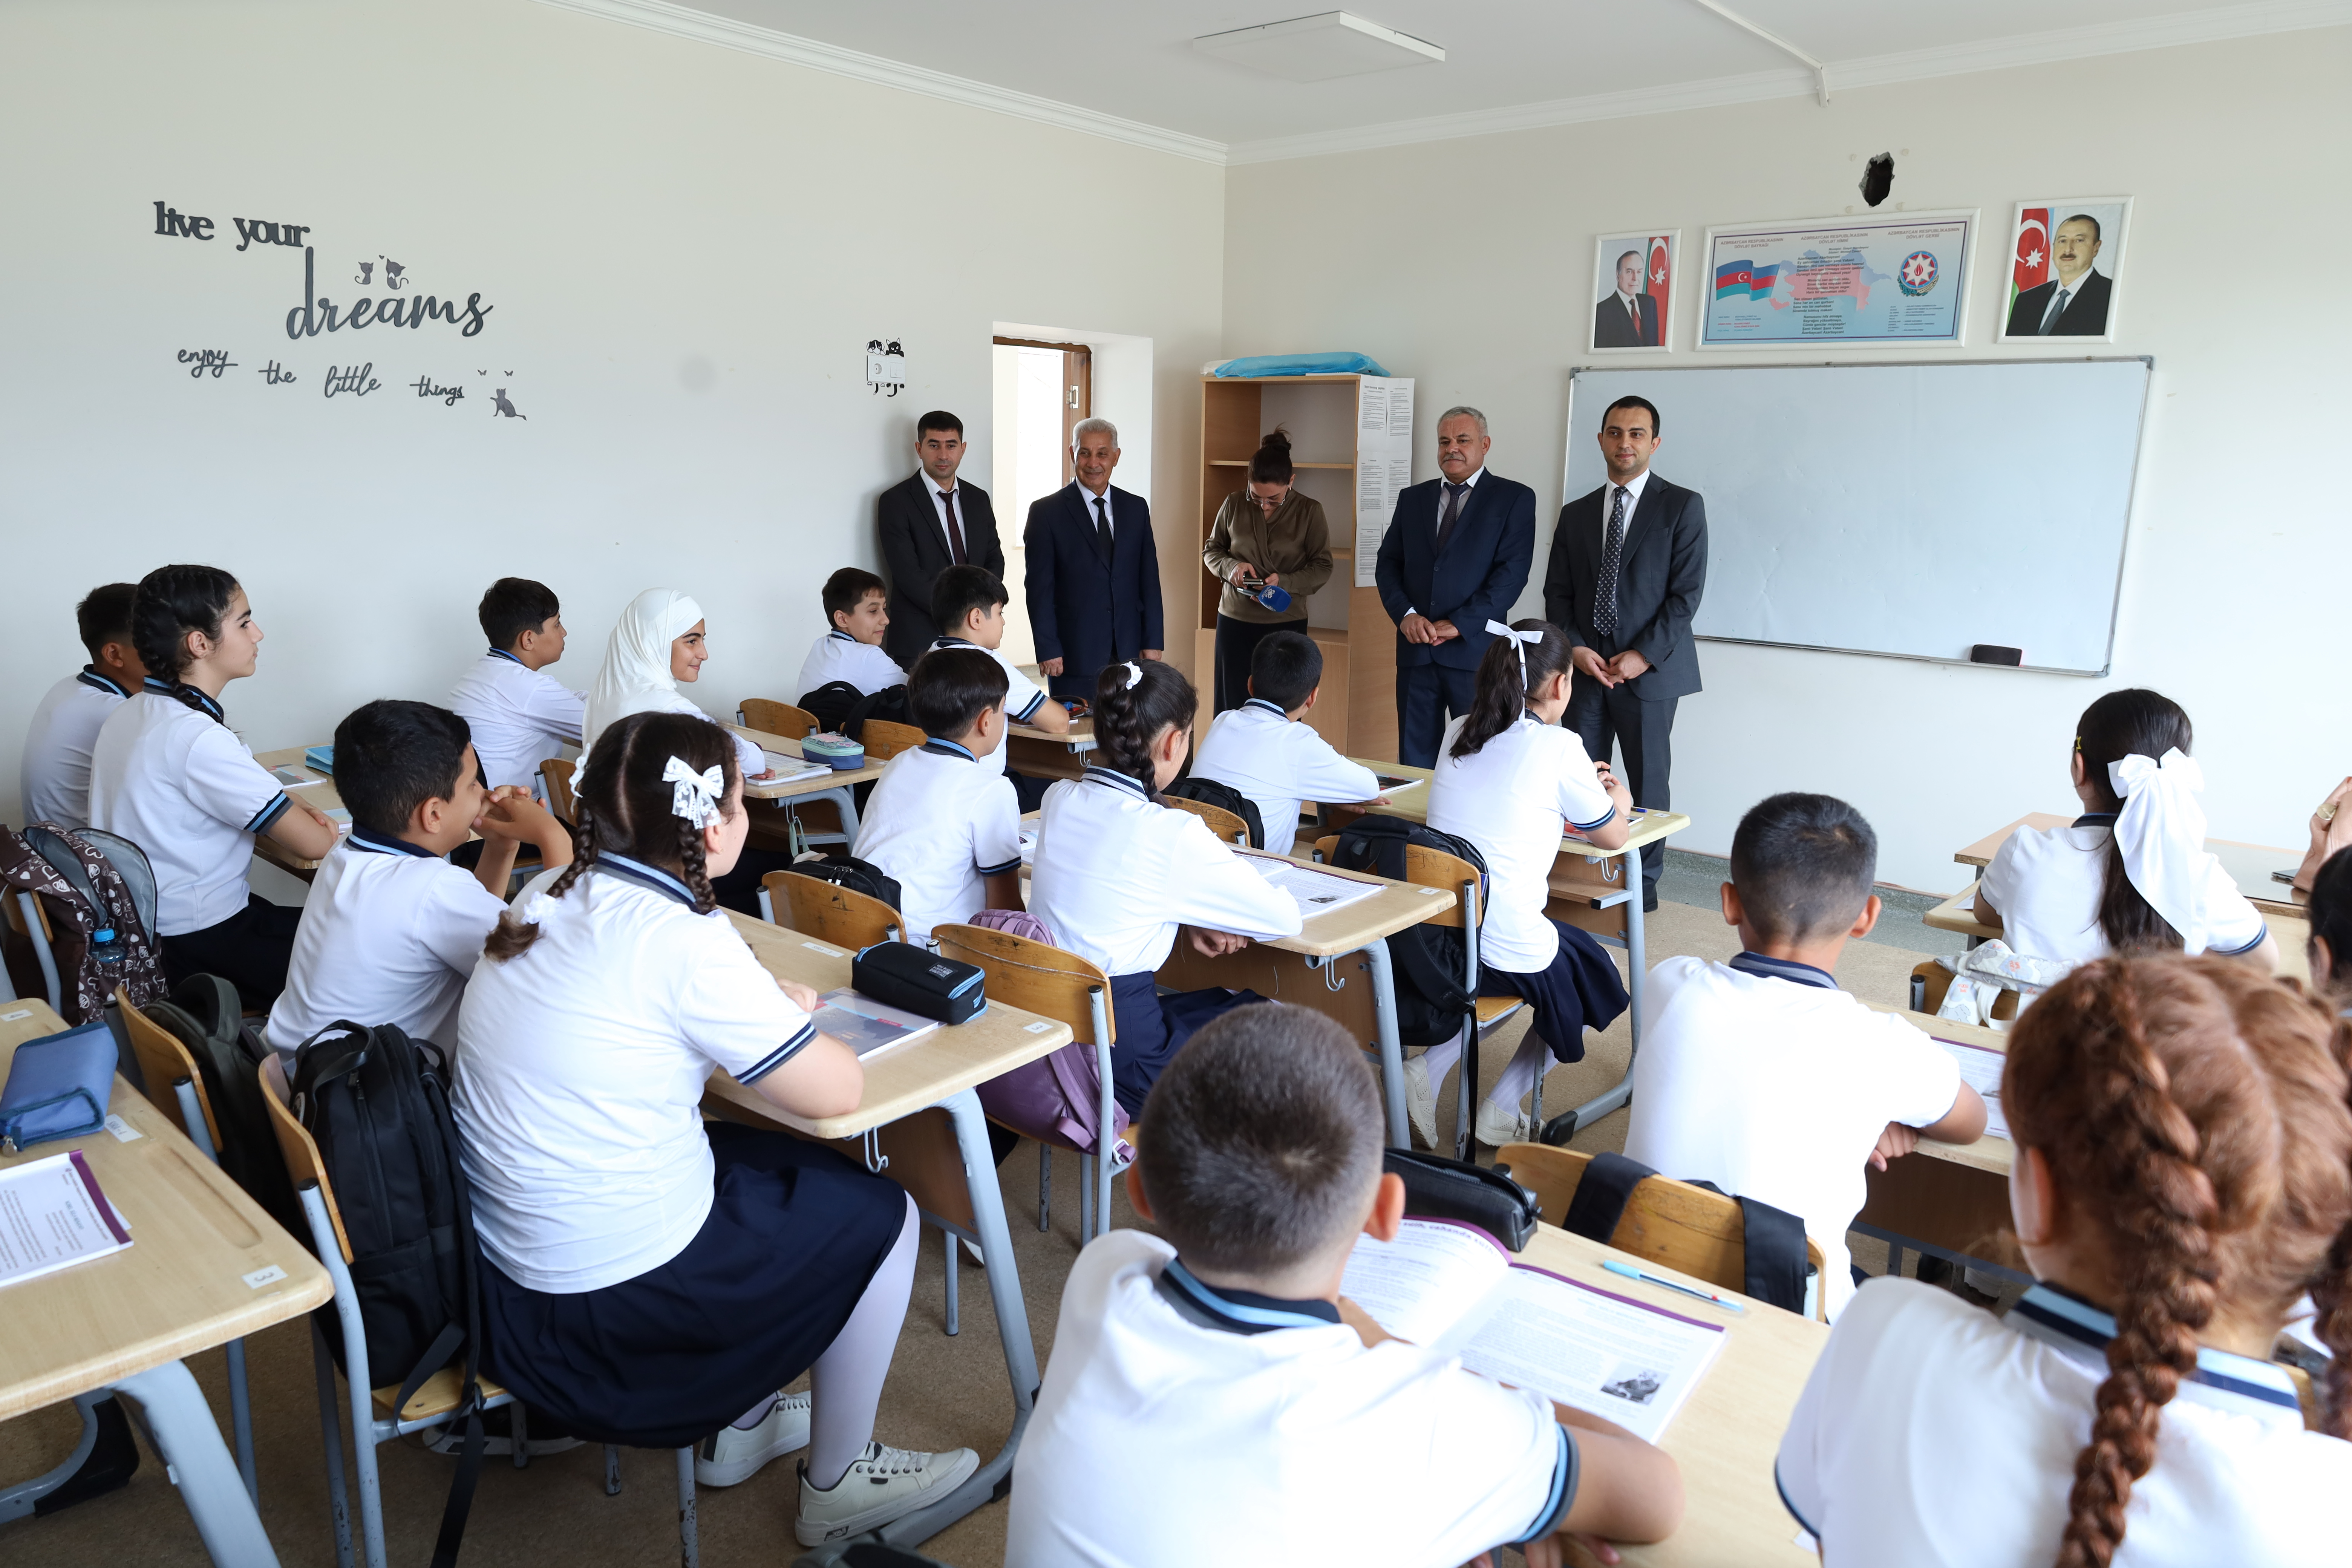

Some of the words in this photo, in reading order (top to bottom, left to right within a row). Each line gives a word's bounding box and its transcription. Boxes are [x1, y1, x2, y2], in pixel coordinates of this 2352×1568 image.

[154, 201, 214, 240] live
[233, 217, 310, 251] your
[287, 247, 493, 340] dreams
[178, 349, 238, 378] enjoy
[259, 360, 296, 384] the
[325, 362, 381, 397] little
[410, 375, 464, 406] things
